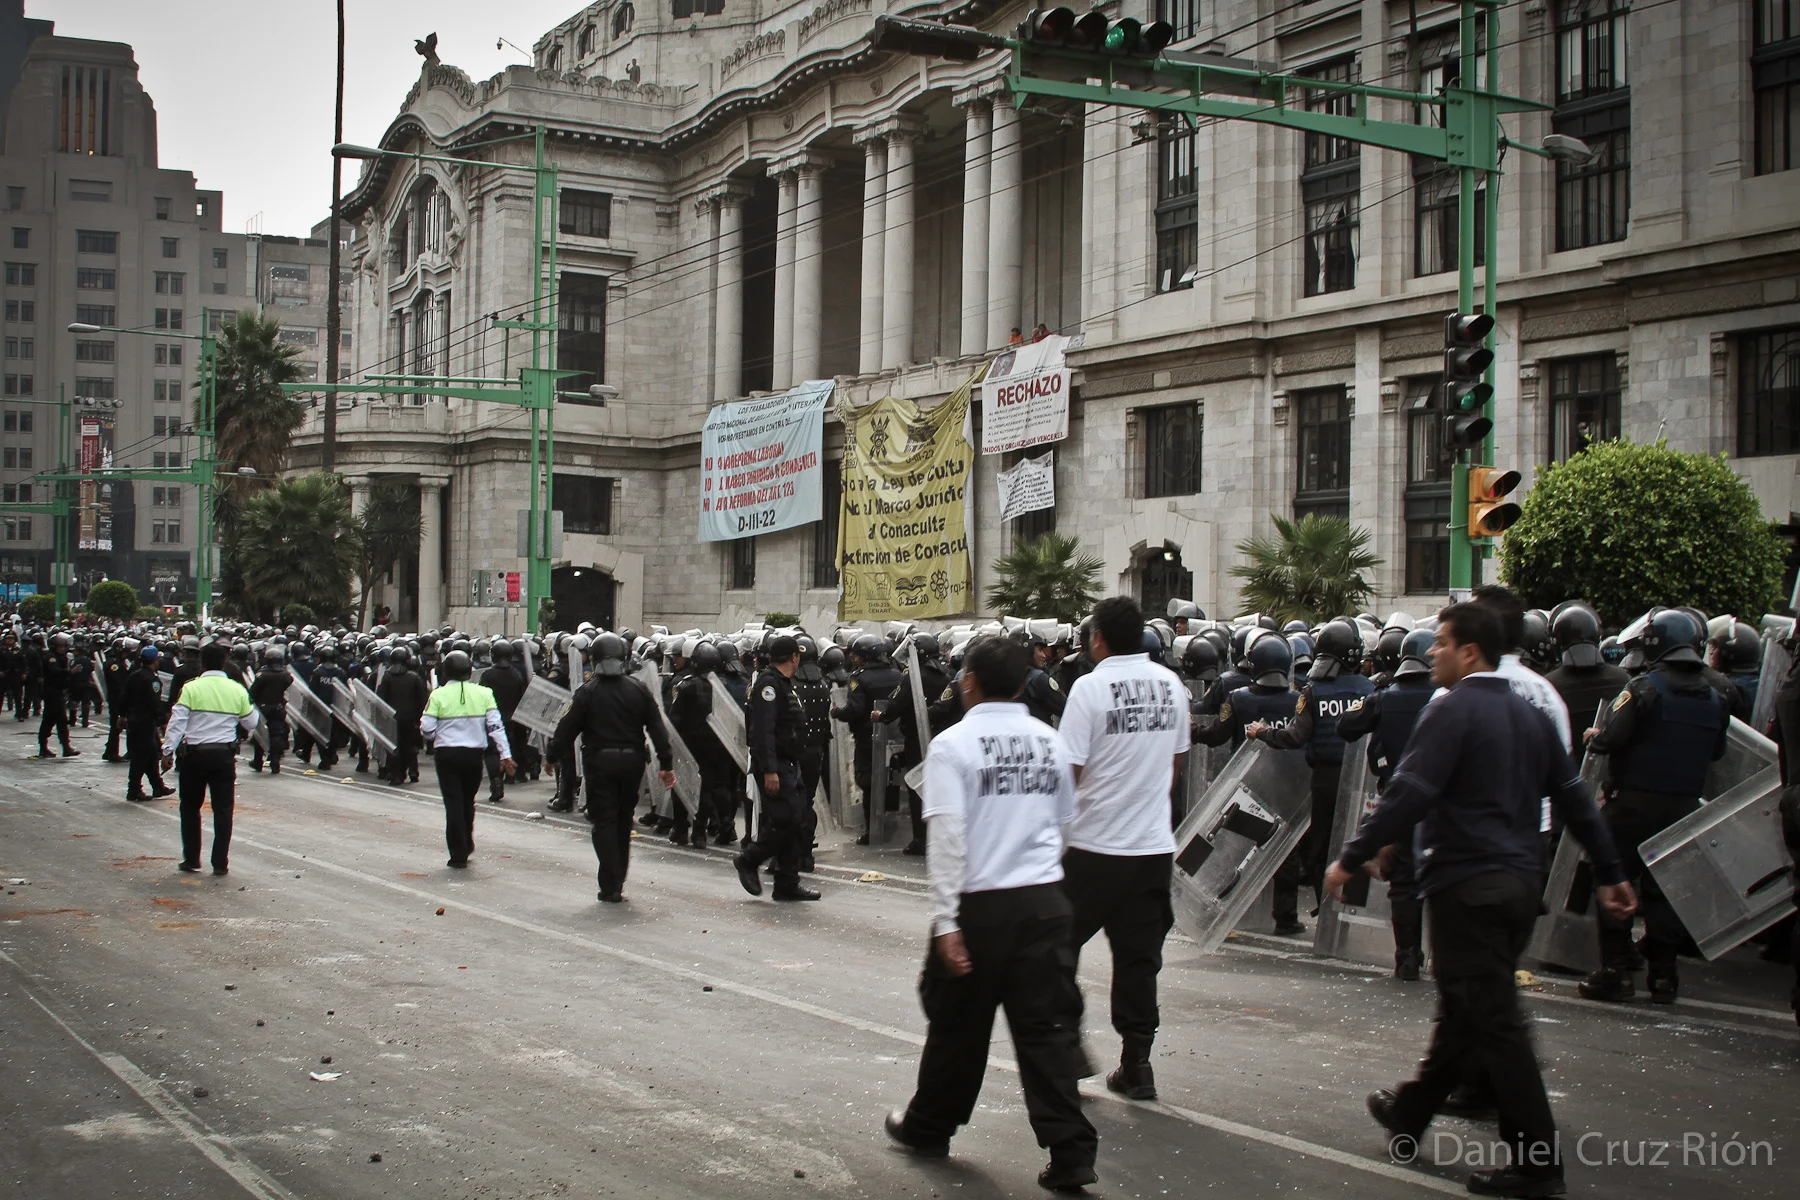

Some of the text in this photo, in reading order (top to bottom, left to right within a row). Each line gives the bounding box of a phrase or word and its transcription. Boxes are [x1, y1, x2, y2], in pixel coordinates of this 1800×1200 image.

[997, 373, 1062, 408] RECHAZO
[783, 480, 794, 498] 123
[881, 473, 905, 494] Ley
[908, 470, 925, 486] de
[876, 498, 912, 515] Marco
[738, 509, 776, 532] D-III-22
[880, 516, 946, 540] Conaculta
[895, 546, 911, 563] de
